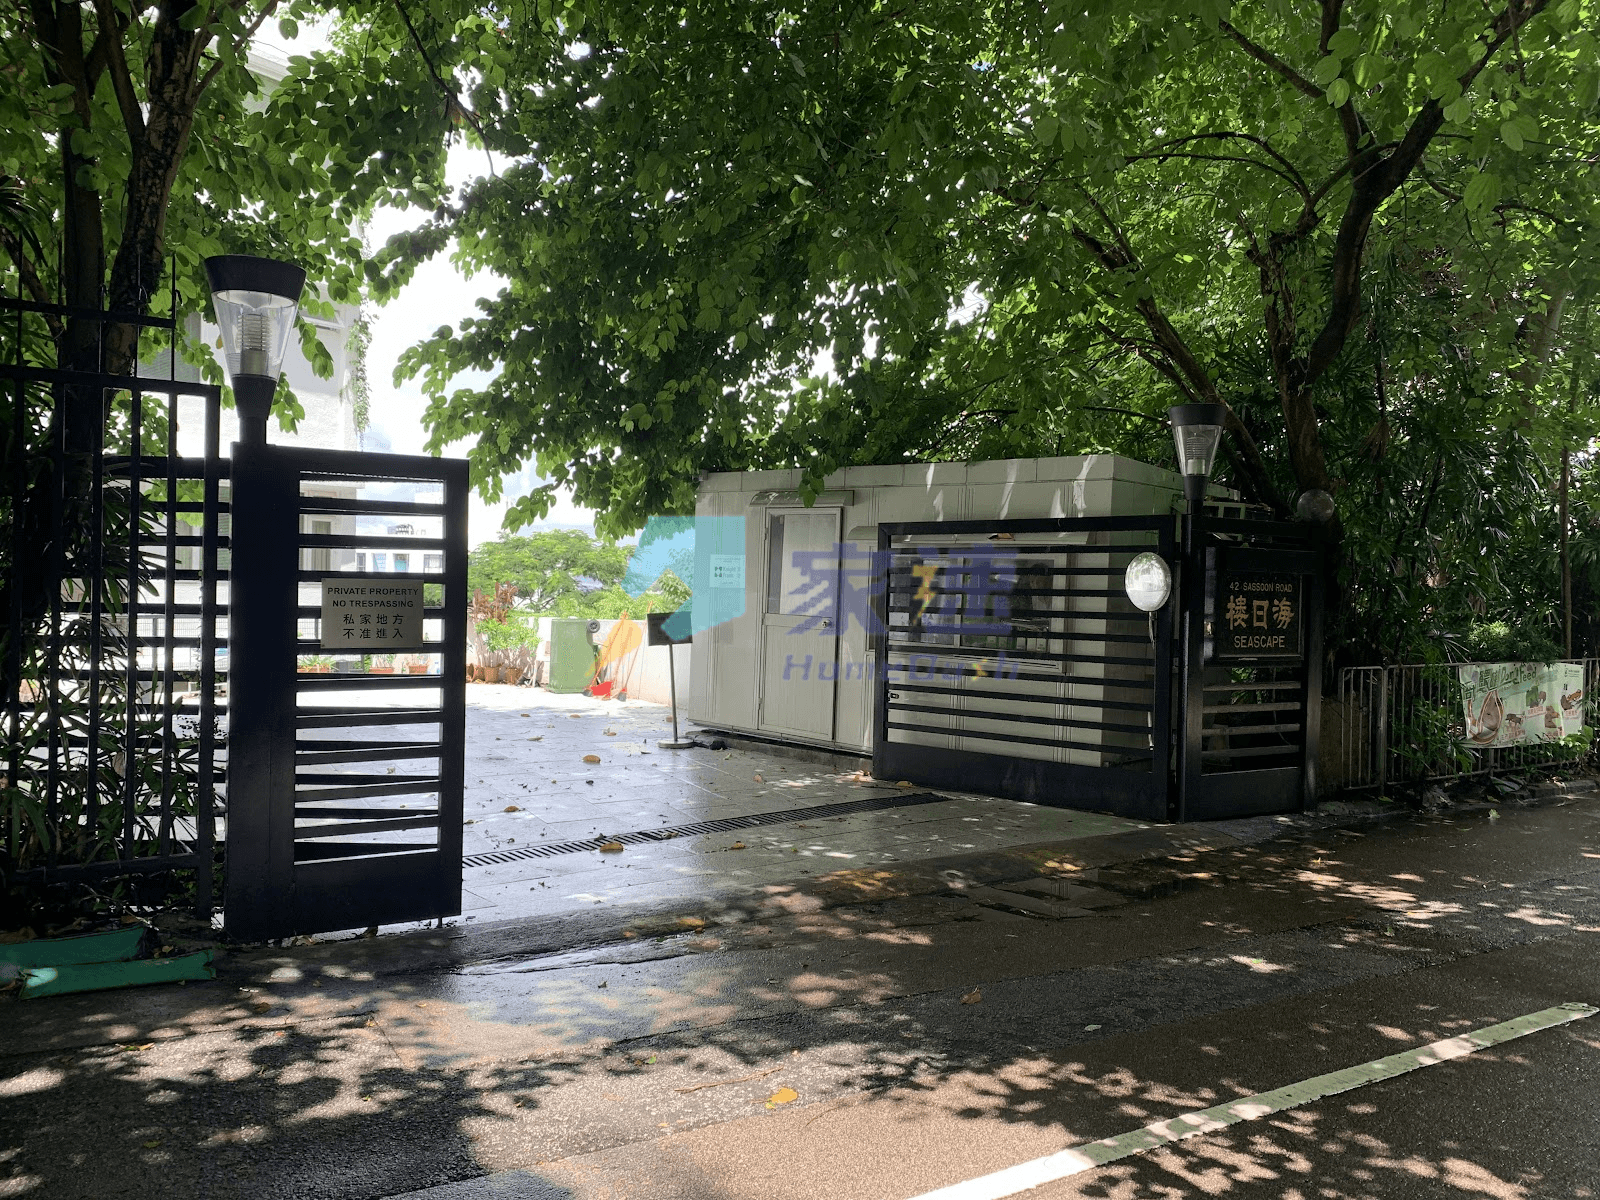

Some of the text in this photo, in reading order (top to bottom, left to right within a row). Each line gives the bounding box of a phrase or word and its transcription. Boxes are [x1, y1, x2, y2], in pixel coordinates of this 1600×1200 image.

[327, 587, 419, 596] PRIVATE PROPERTY
[1229, 581, 1293, 593] 42 SASSOON ROAD
[332, 600, 414, 608] NO TRESPASSING
[343, 613, 404, 625] 私家地方
[342, 627, 404, 640] 不准進入
[1233, 635, 1286, 648] SEASCAPE
